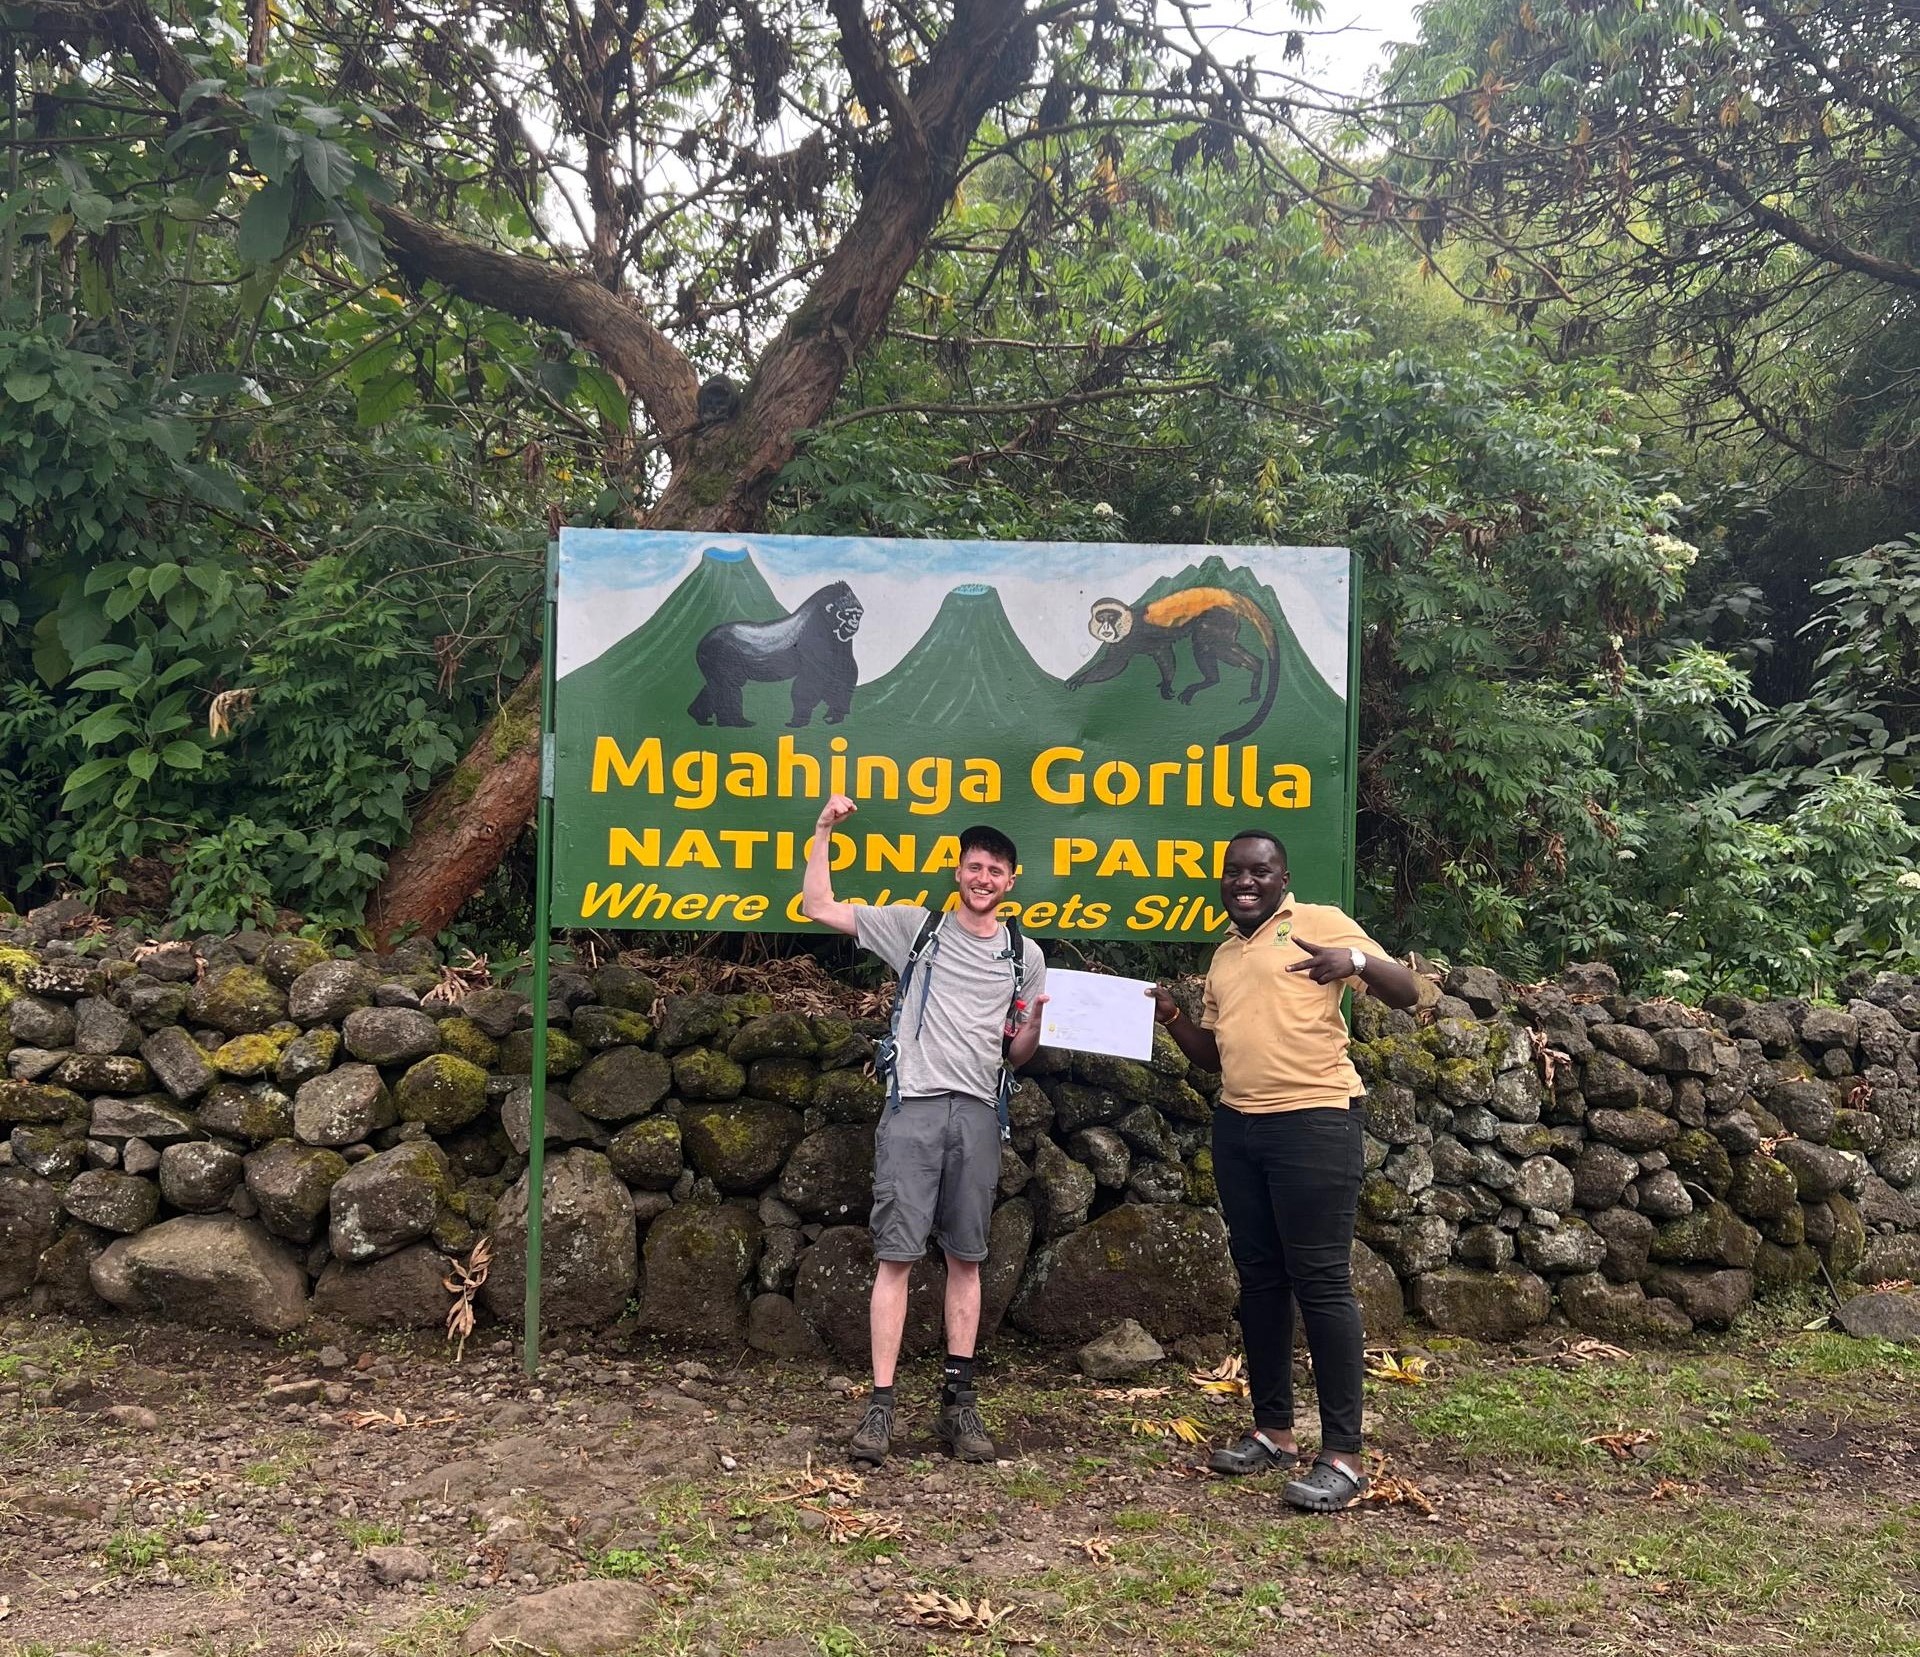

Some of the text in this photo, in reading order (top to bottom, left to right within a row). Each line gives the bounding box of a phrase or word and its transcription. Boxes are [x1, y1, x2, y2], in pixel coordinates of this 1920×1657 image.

[591, 735, 1312, 815] Mgahinga Gorilla
[608, 827, 1023, 875] NATIONA
[580, 881, 769, 922] Where
[1126, 894, 1230, 933] Silv
